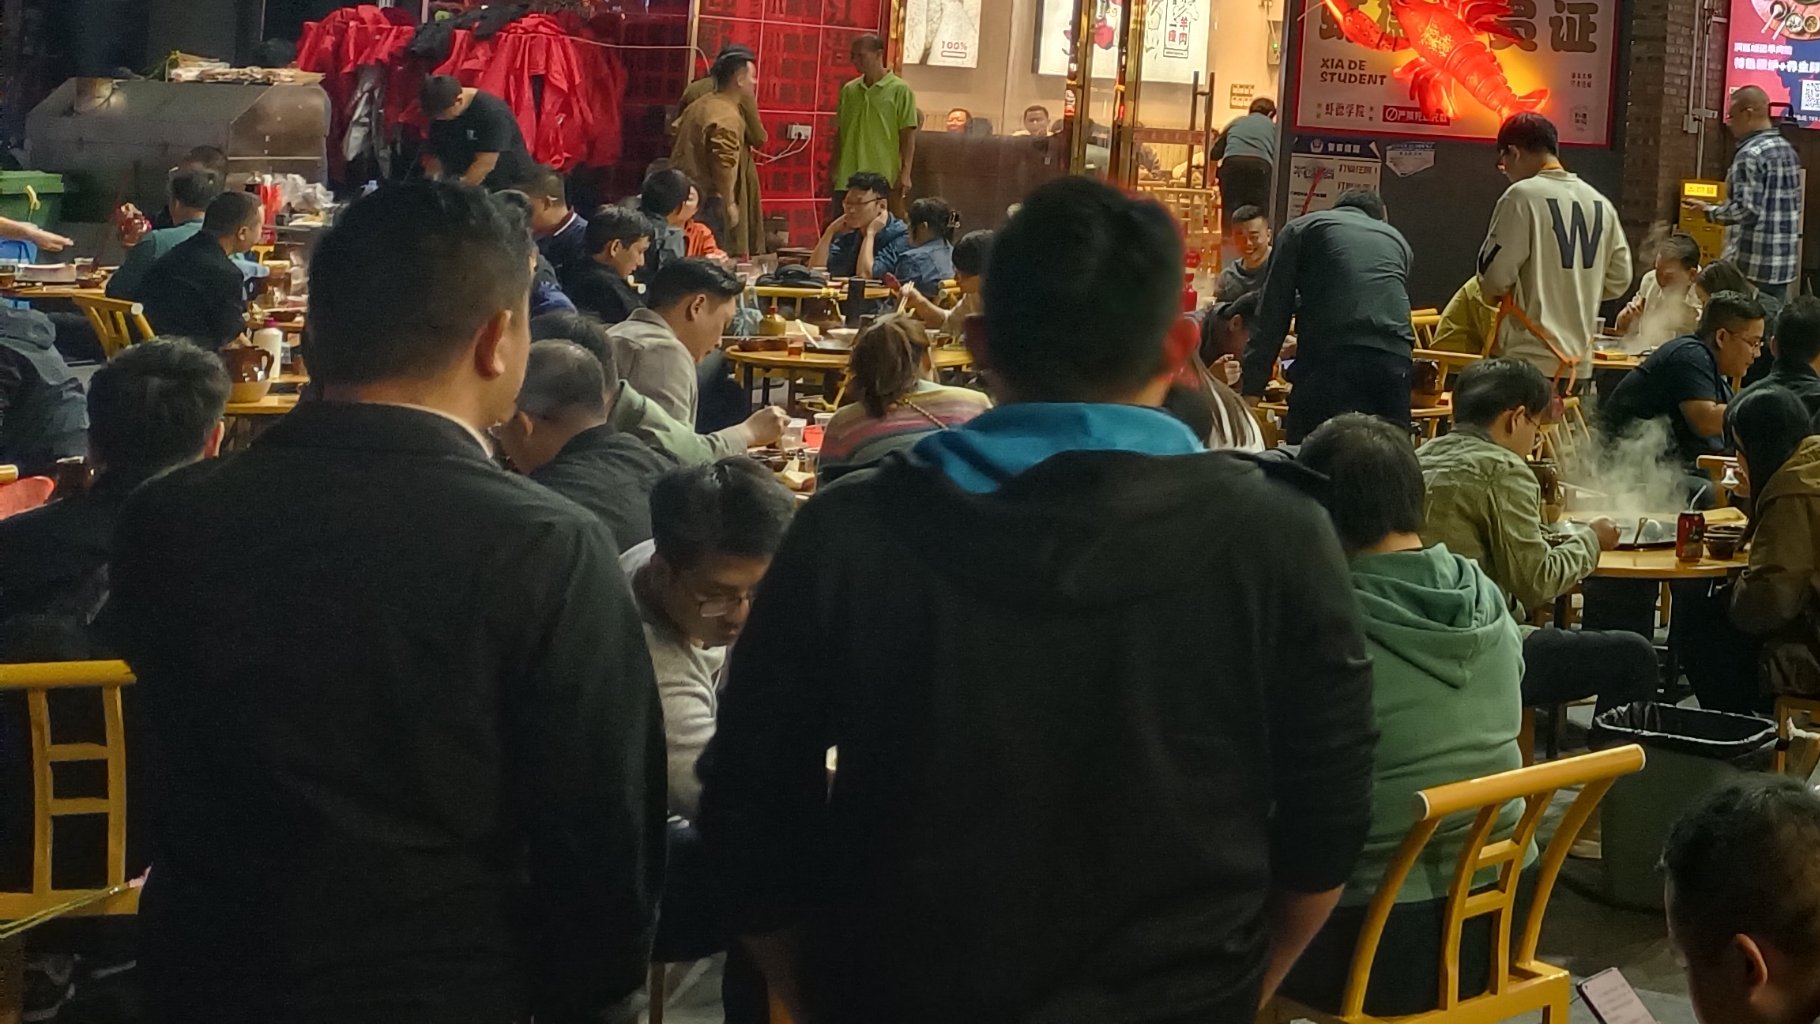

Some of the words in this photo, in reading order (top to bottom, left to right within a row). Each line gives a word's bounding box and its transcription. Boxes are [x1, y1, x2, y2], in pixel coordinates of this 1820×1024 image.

[941, 41, 968, 52] 100%
[1319, 58, 1345, 71] XIA
[1348, 59, 1367, 71] DE
[1319, 71, 1388, 86] STUDENT
[1546, 198, 1604, 270] W
